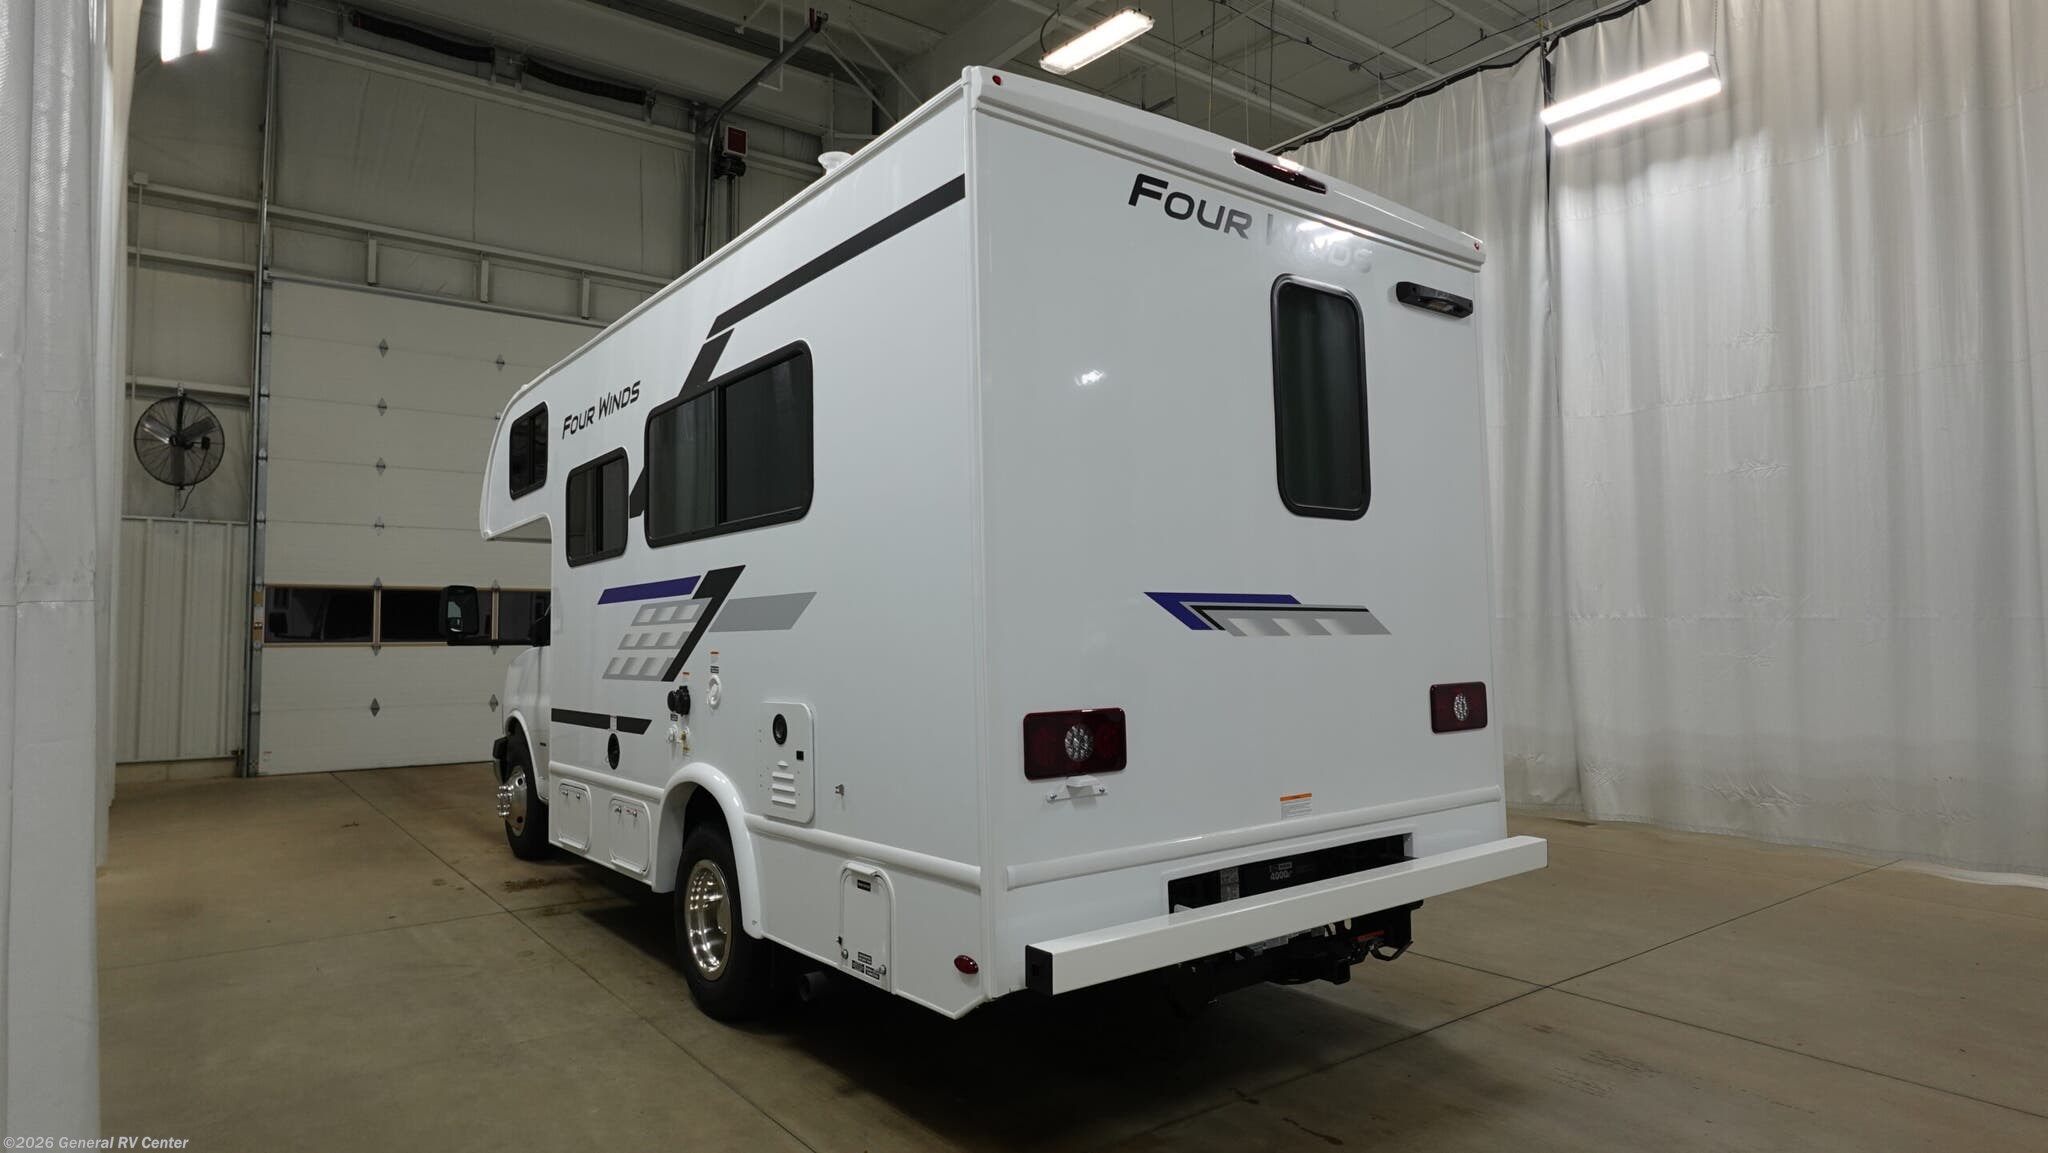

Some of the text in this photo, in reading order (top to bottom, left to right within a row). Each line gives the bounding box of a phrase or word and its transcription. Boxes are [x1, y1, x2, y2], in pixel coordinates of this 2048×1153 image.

[1128, 173, 1252, 240] FOUR
[561, 380, 641, 440] FOUR WINDS
